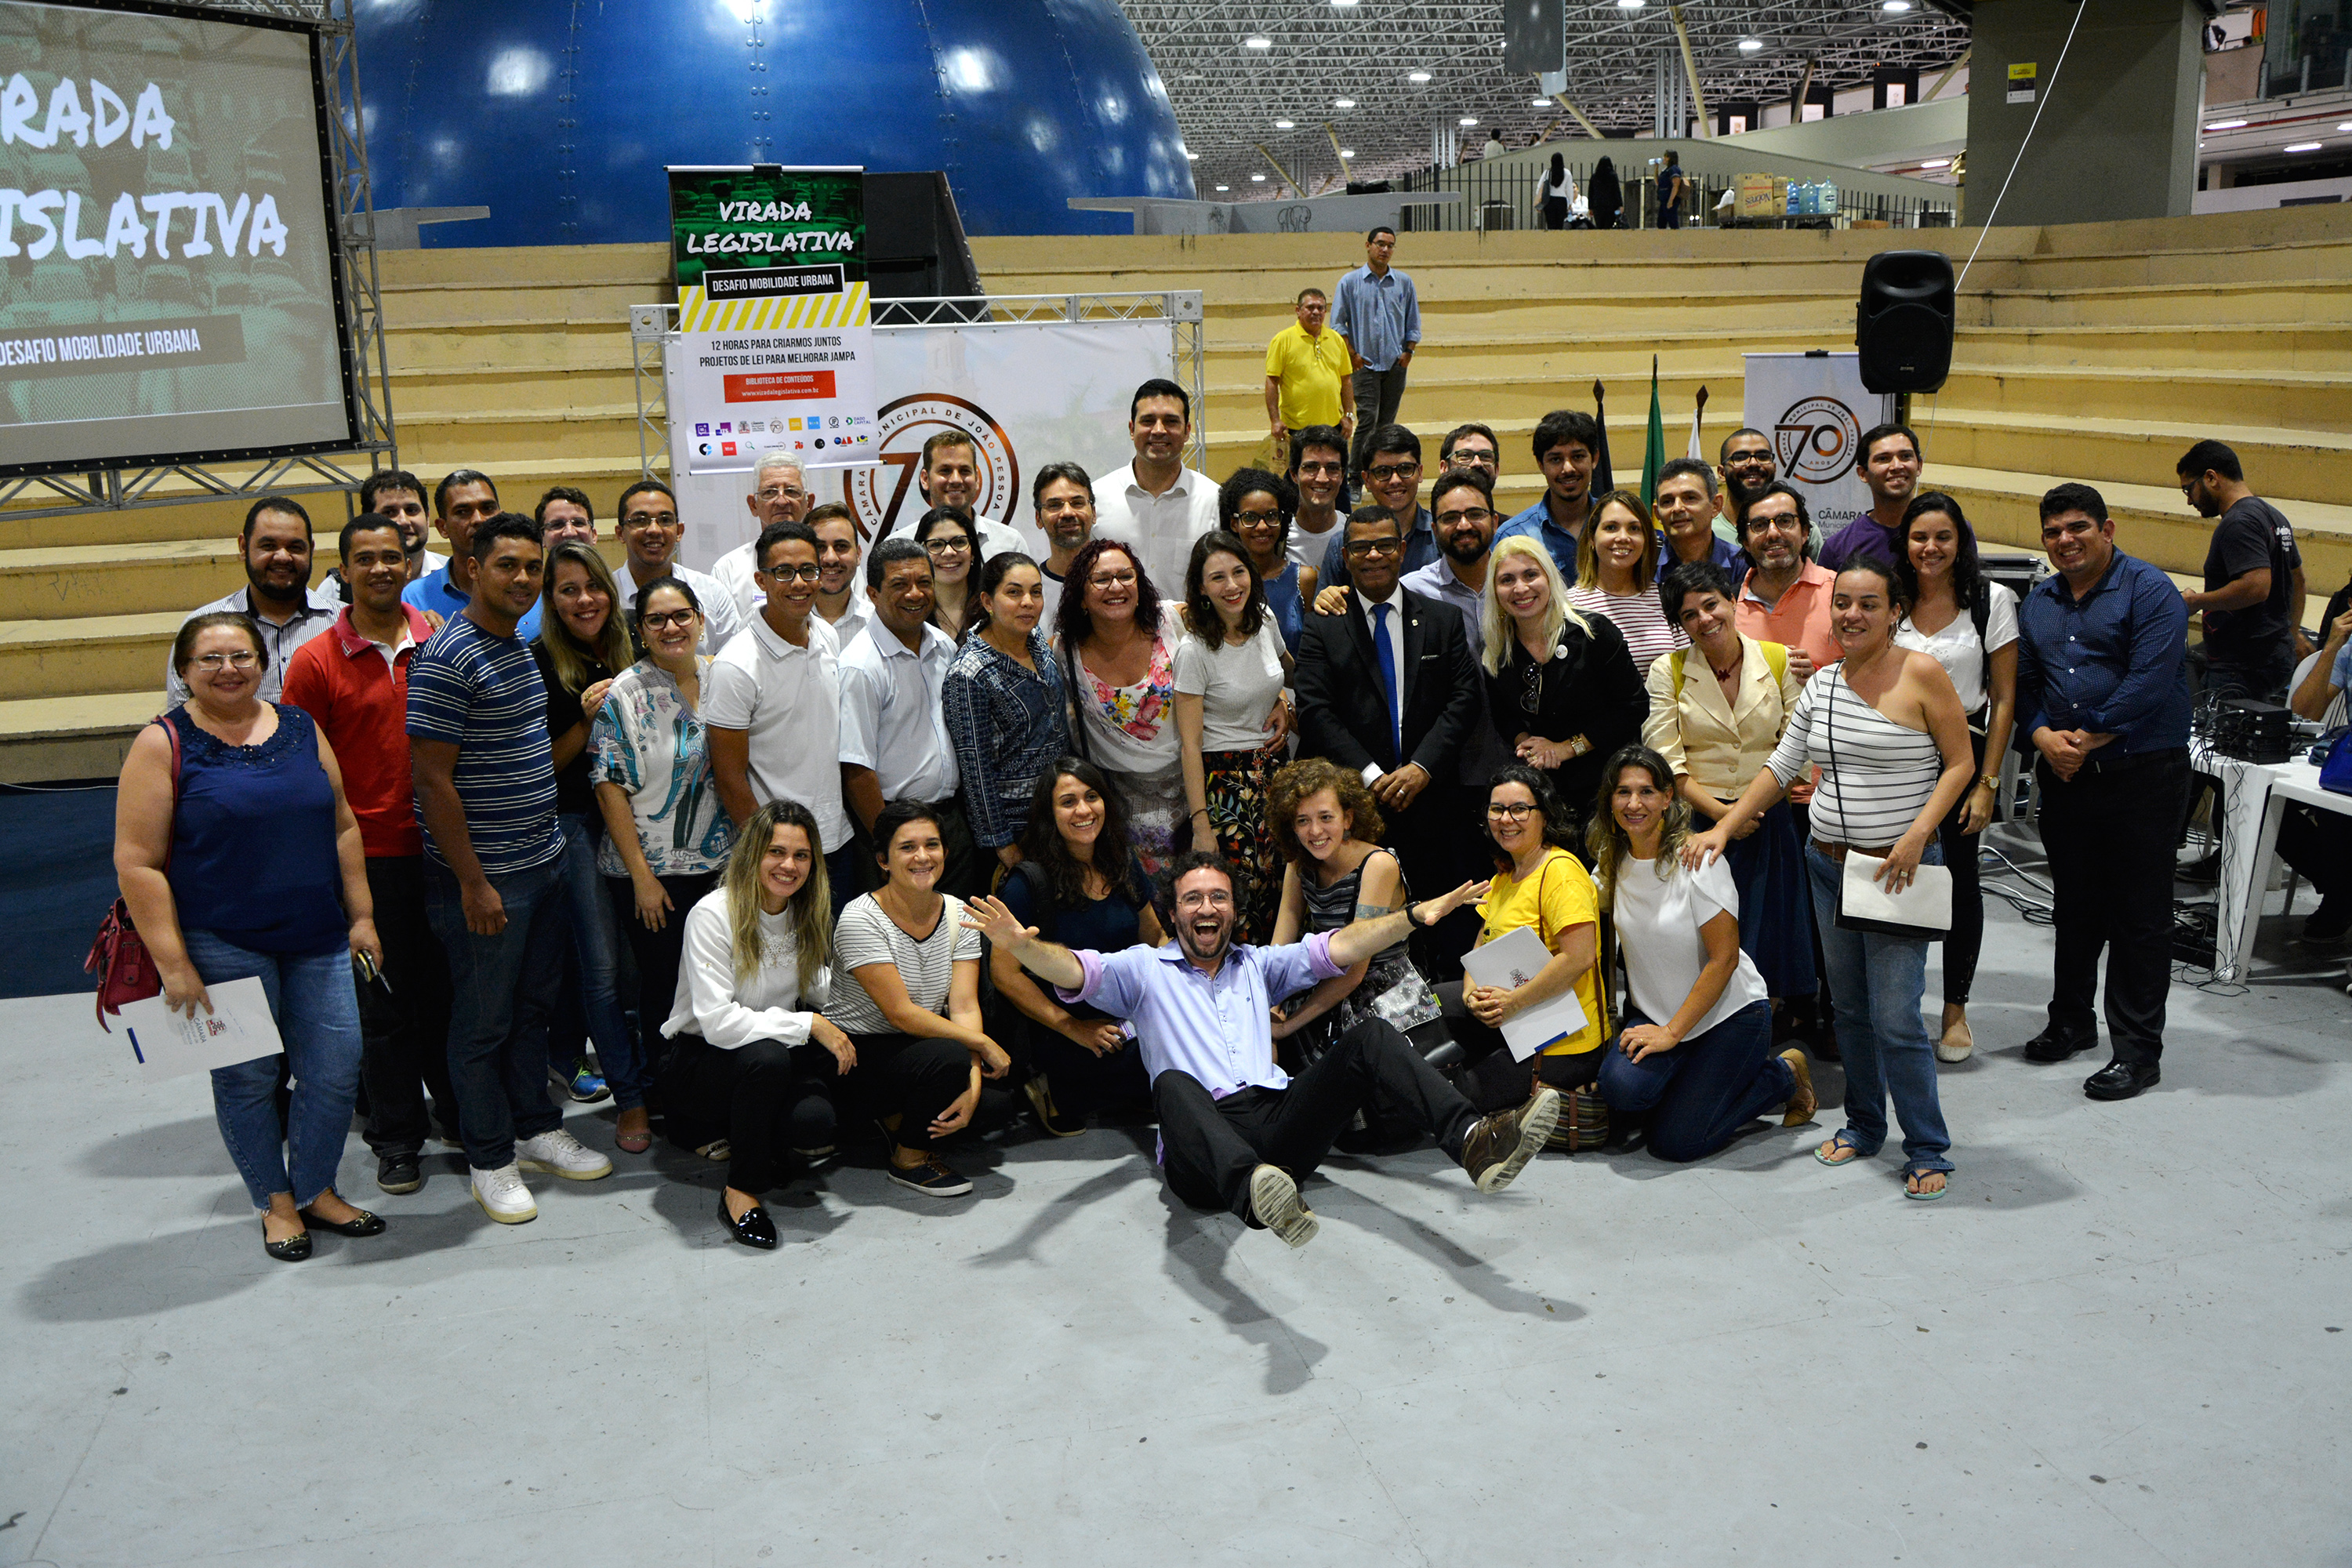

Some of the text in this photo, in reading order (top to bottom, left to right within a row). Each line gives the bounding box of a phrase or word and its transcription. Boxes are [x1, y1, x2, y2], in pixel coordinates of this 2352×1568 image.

[0, 72, 176, 151] RADA
[719, 201, 812, 222] VIRADA
[686, 230, 855, 254] LEGISLATIVA
[712, 274, 834, 292] DESAFIO MOBILIDADE URBANA
[58, 332, 144, 362] MOBILIDADE
[145, 328, 201, 356] URBANA
[711, 336, 841, 350] 12 HORAS PARA CRIARMOS JUNTOS
[699, 351, 855, 367] PROJETOS DE LEI PARA MELHORAR JAMPA
[746, 374, 814, 386] BIBLIOTECA DE CONTEÚDOS
[742, 387, 819, 397] www.viradalegislativa.com.br
[1788, 403, 1824, 422] MUNICIPAL
[946, 409, 961, 420] DE
[968, 421, 995, 448] JOÃO
[993, 456, 1005, 510] PESSOA
[1774, 424, 1843, 480] 70
